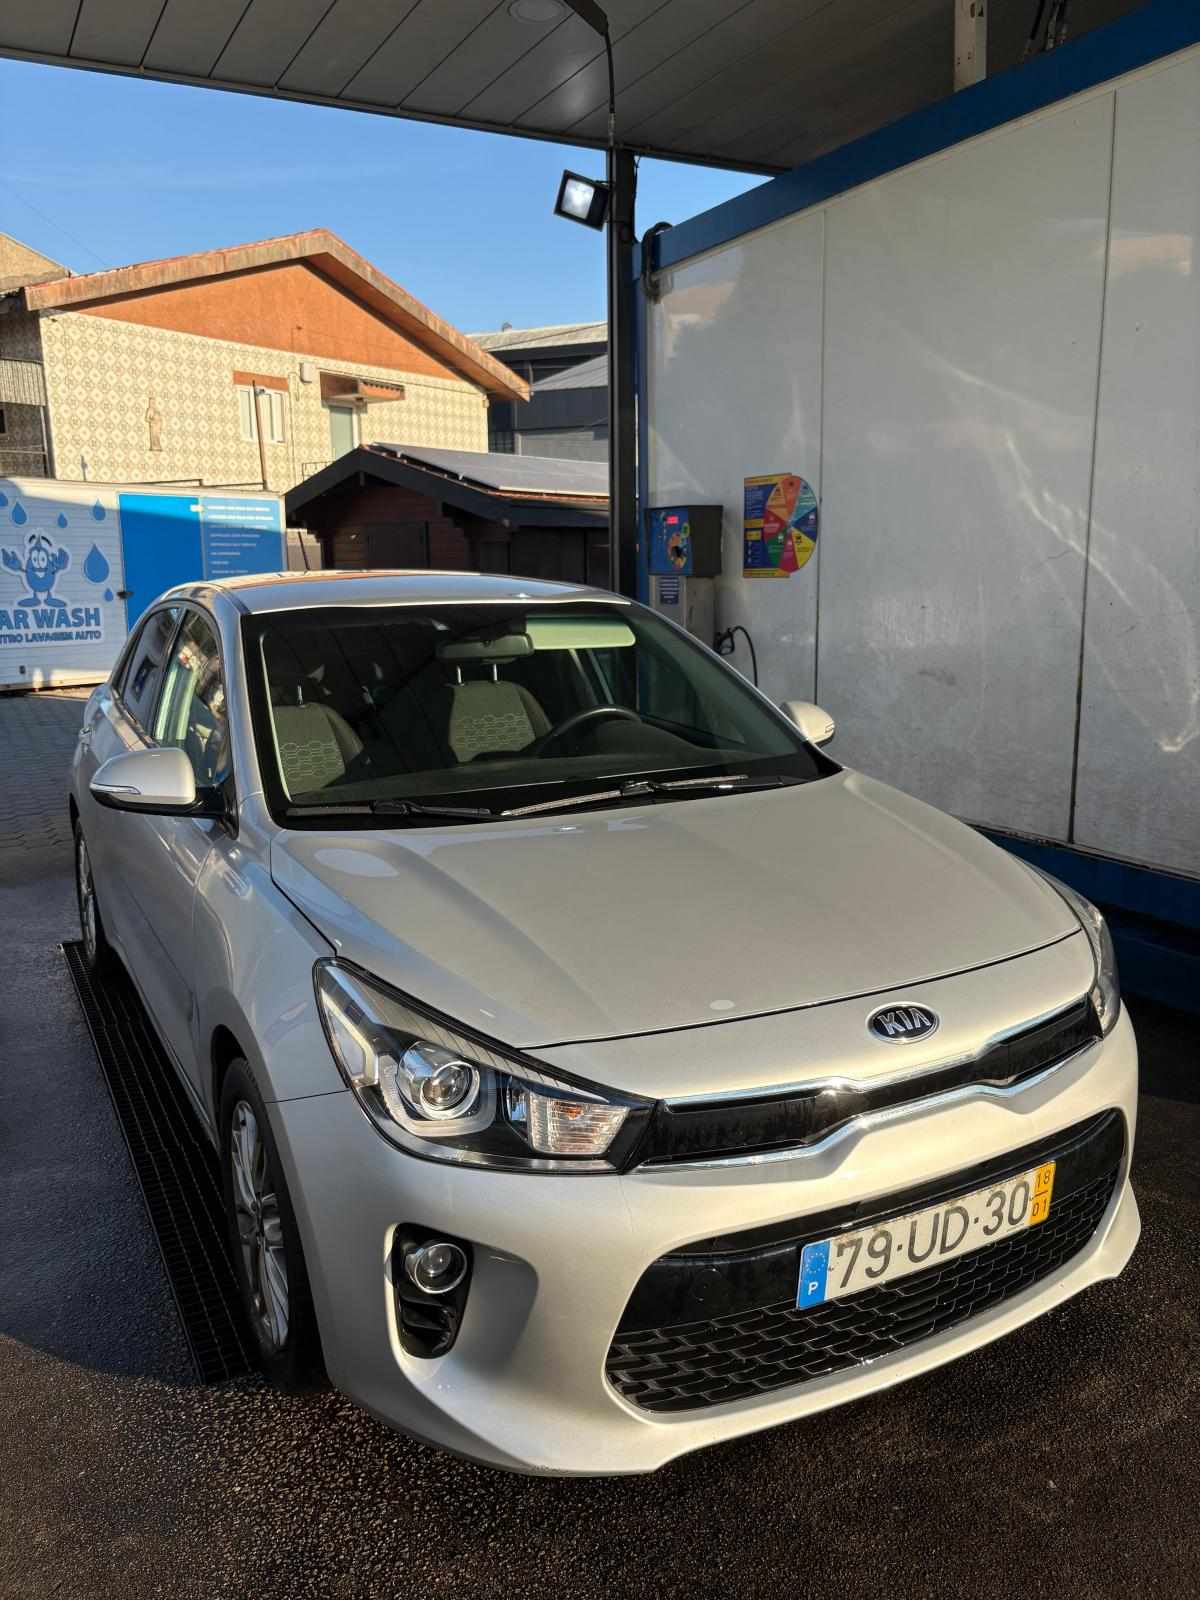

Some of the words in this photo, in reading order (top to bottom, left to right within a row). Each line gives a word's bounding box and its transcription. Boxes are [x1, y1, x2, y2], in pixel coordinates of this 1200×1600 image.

[0, 608, 30, 630] AR
[32, 607, 101, 629] WASH
[75, 630, 102, 641] AUTO
[878, 1007, 931, 1035] KIA
[1036, 1169, 1051, 1188] 18
[1032, 1199, 1048, 1217] 01
[807, 1281, 818, 1296] P
